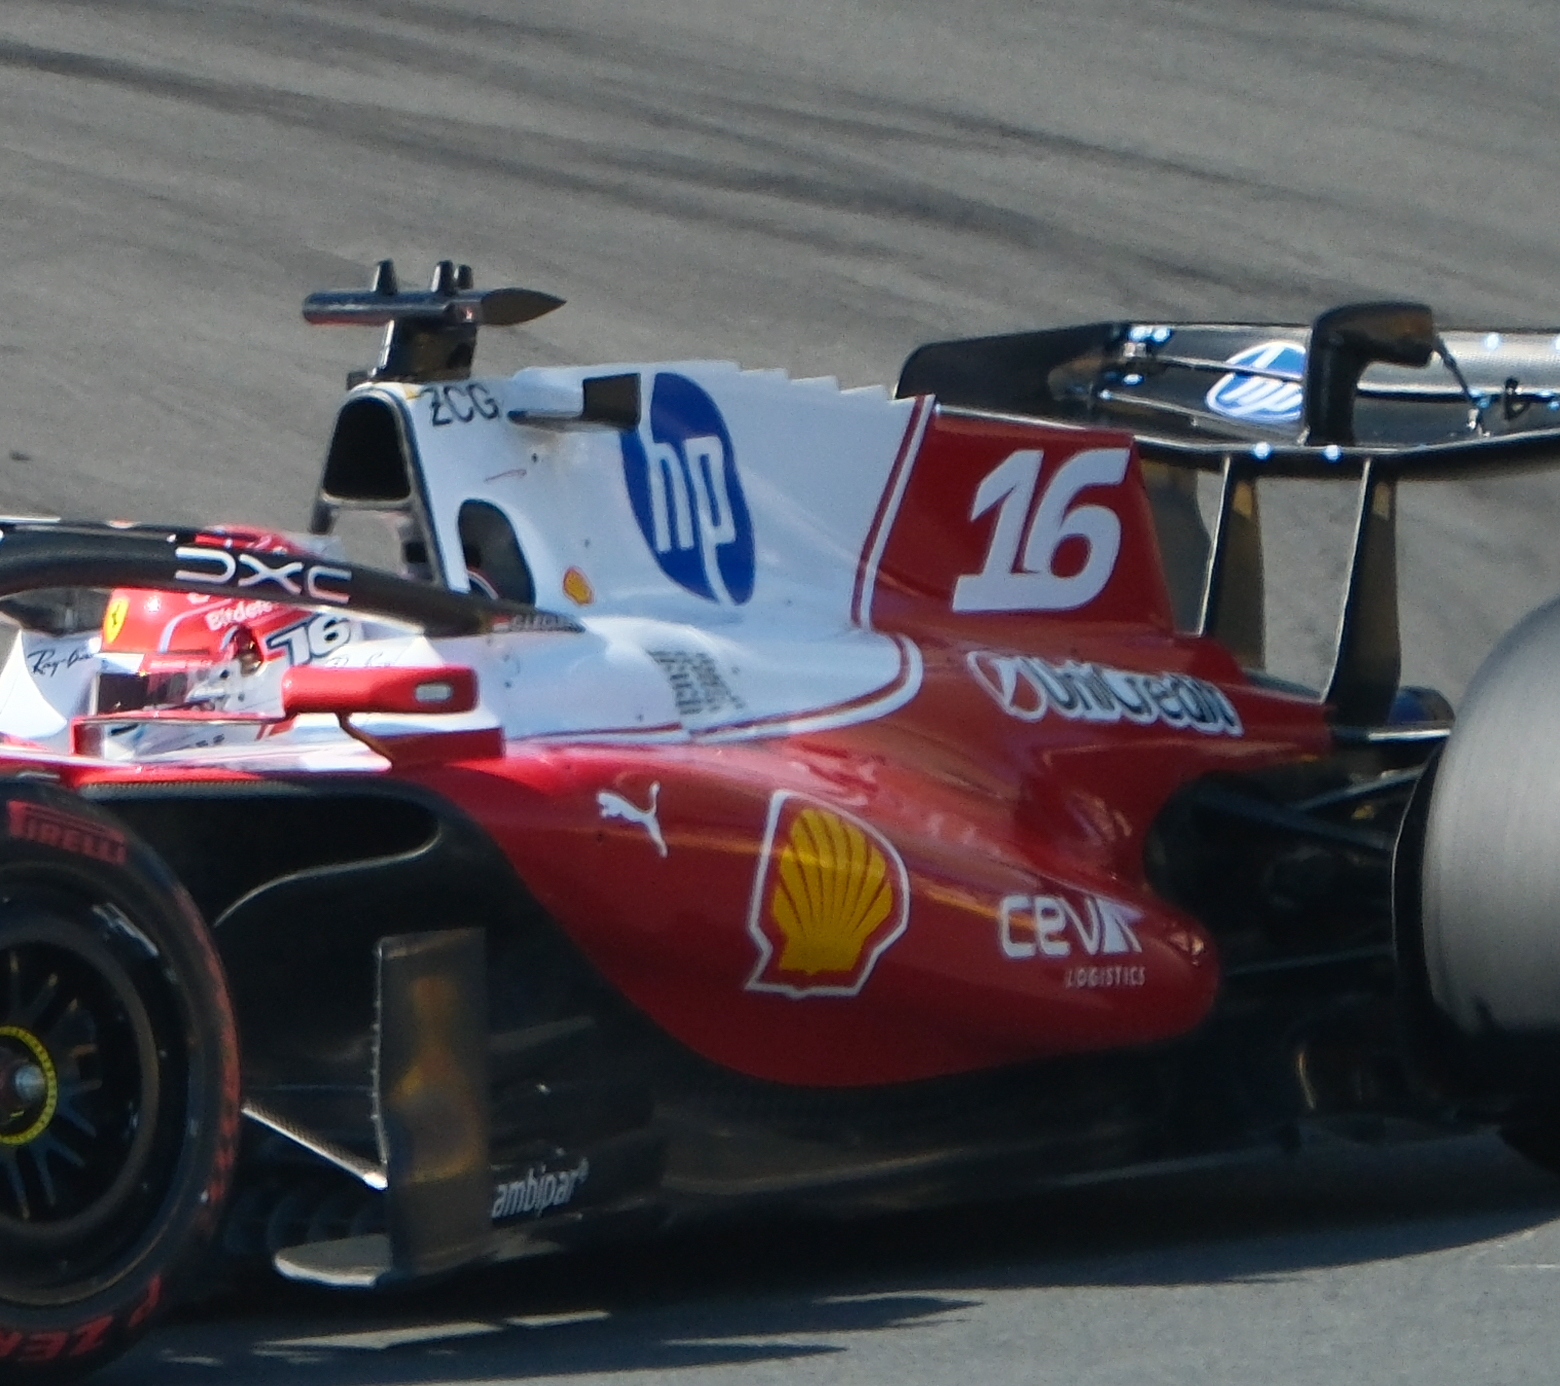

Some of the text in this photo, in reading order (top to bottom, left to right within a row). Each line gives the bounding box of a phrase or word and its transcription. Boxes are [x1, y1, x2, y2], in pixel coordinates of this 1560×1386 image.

[633, 373, 737, 605] hp
[952, 447, 1131, 613] 16
[175, 546, 352, 604] DXC
[266, 615, 353, 667] 16
[1017, 656, 1237, 727] UniCredit
[6, 799, 126, 864] PIRELLI
[1065, 965, 1146, 988] LOGISTICS
[491, 1163, 579, 1219] ambipar
